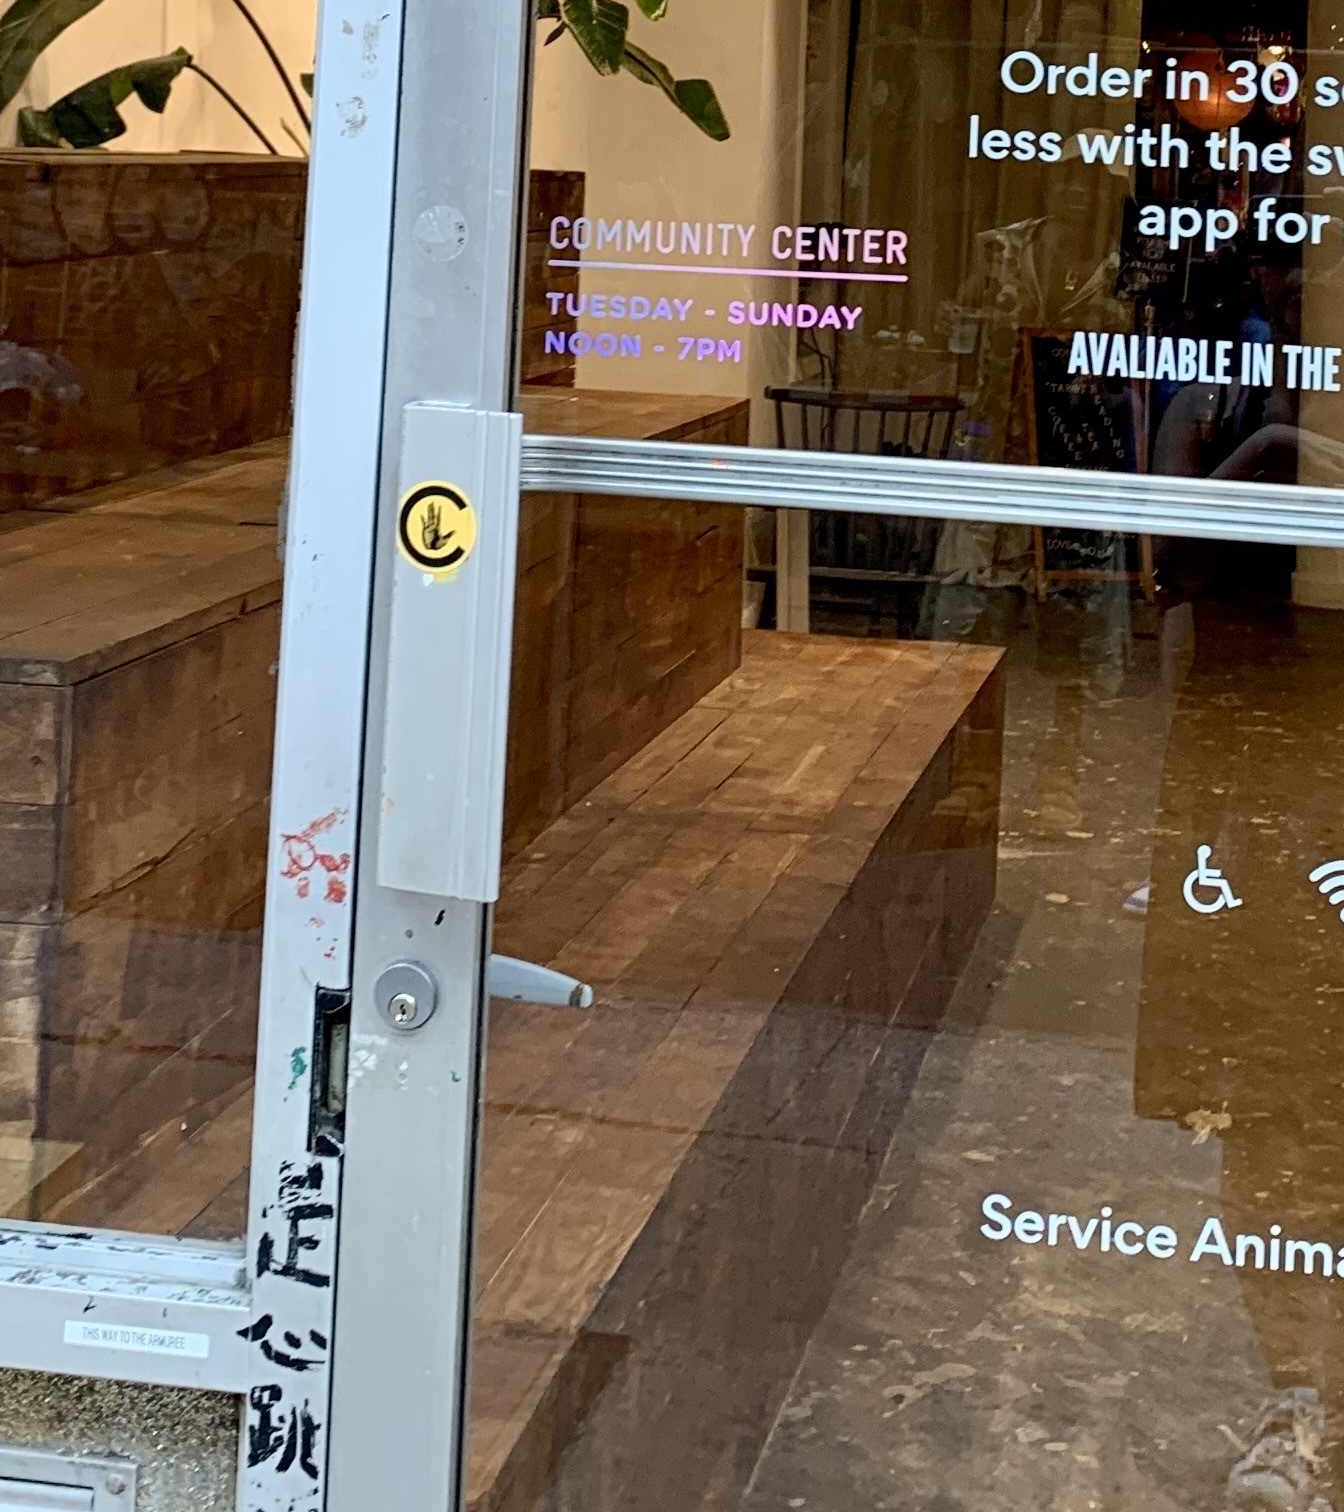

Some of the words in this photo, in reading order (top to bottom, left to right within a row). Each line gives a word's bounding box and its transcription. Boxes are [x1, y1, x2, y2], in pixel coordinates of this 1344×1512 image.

[1000, 49, 1154, 98] Order
[1165, 56, 1208, 100] in
[1227, 59, 1299, 106] 30
[968, 114, 1062, 163] less
[1077, 122, 1190, 170] with
[1204, 126, 1293, 175] the
[548, 214, 757, 258] COMMUNITY
[770, 224, 910, 266] CENTER
[1137, 204, 1239, 253] app
[1252, 196, 1331, 245] for
[544, 291, 695, 322] TUESDAY
[726, 299, 864, 331] SUNDAY
[543, 330, 643, 359] NOON
[676, 335, 743, 364] 7PM
[1066, 330, 1234, 384] AVALIABLE
[1240, 341, 1275, 388] IN
[1281, 343, 1342, 393] THE
[979, 1192, 1179, 1258] Service
[82, 1326, 100, 1341] THIS
[101, 1328, 118, 1342] WAY
[119, 1330, 130, 1344] TO
[132, 1331, 147, 1346] THE
